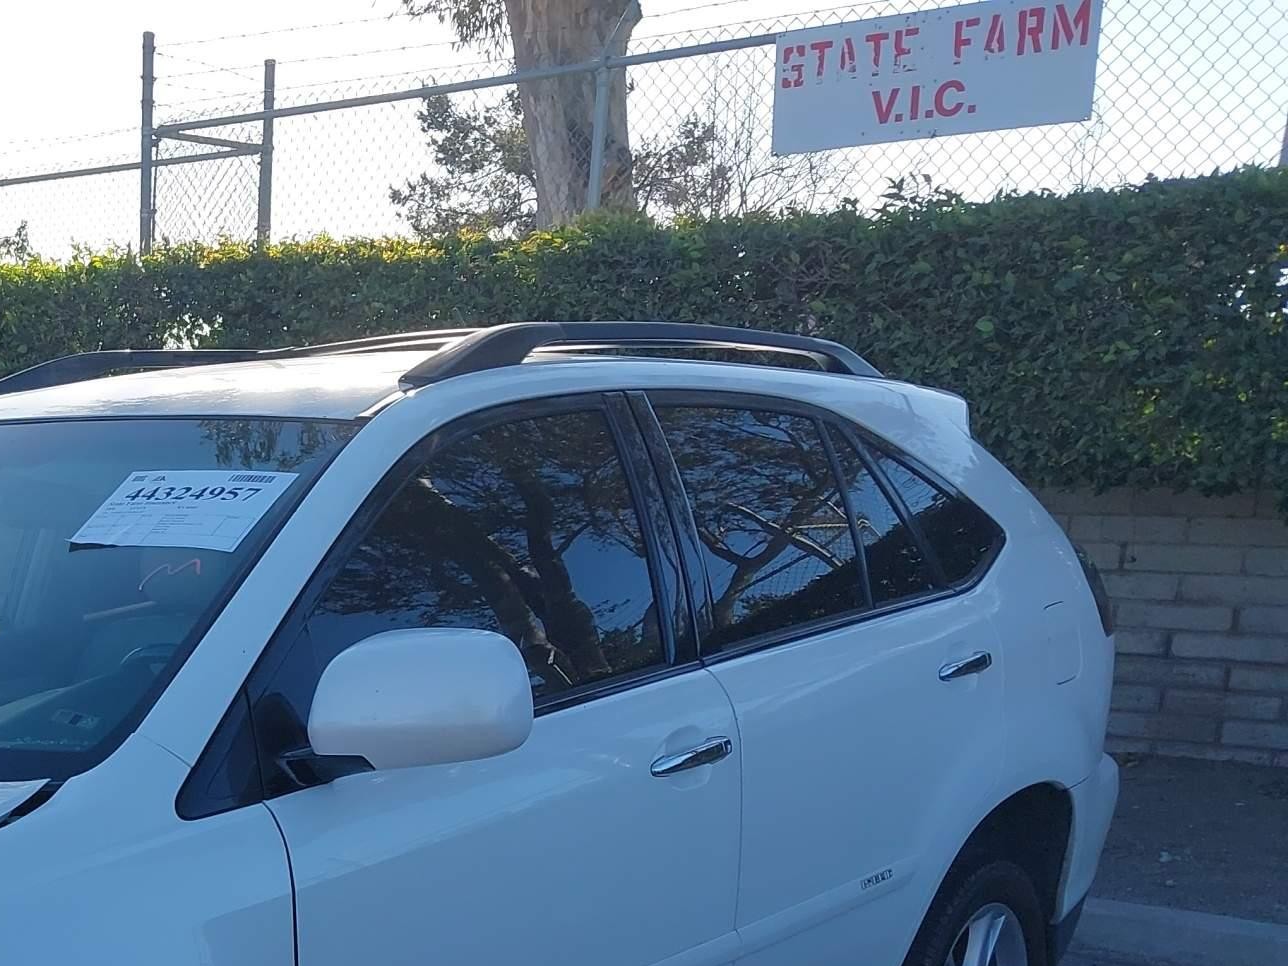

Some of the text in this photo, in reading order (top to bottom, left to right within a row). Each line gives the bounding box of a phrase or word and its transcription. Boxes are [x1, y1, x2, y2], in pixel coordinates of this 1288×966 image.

[781, 0, 1092, 88] STATE FARM
[872, 79, 976, 124] V.I.C.
[124, 485, 263, 502] 44324957
